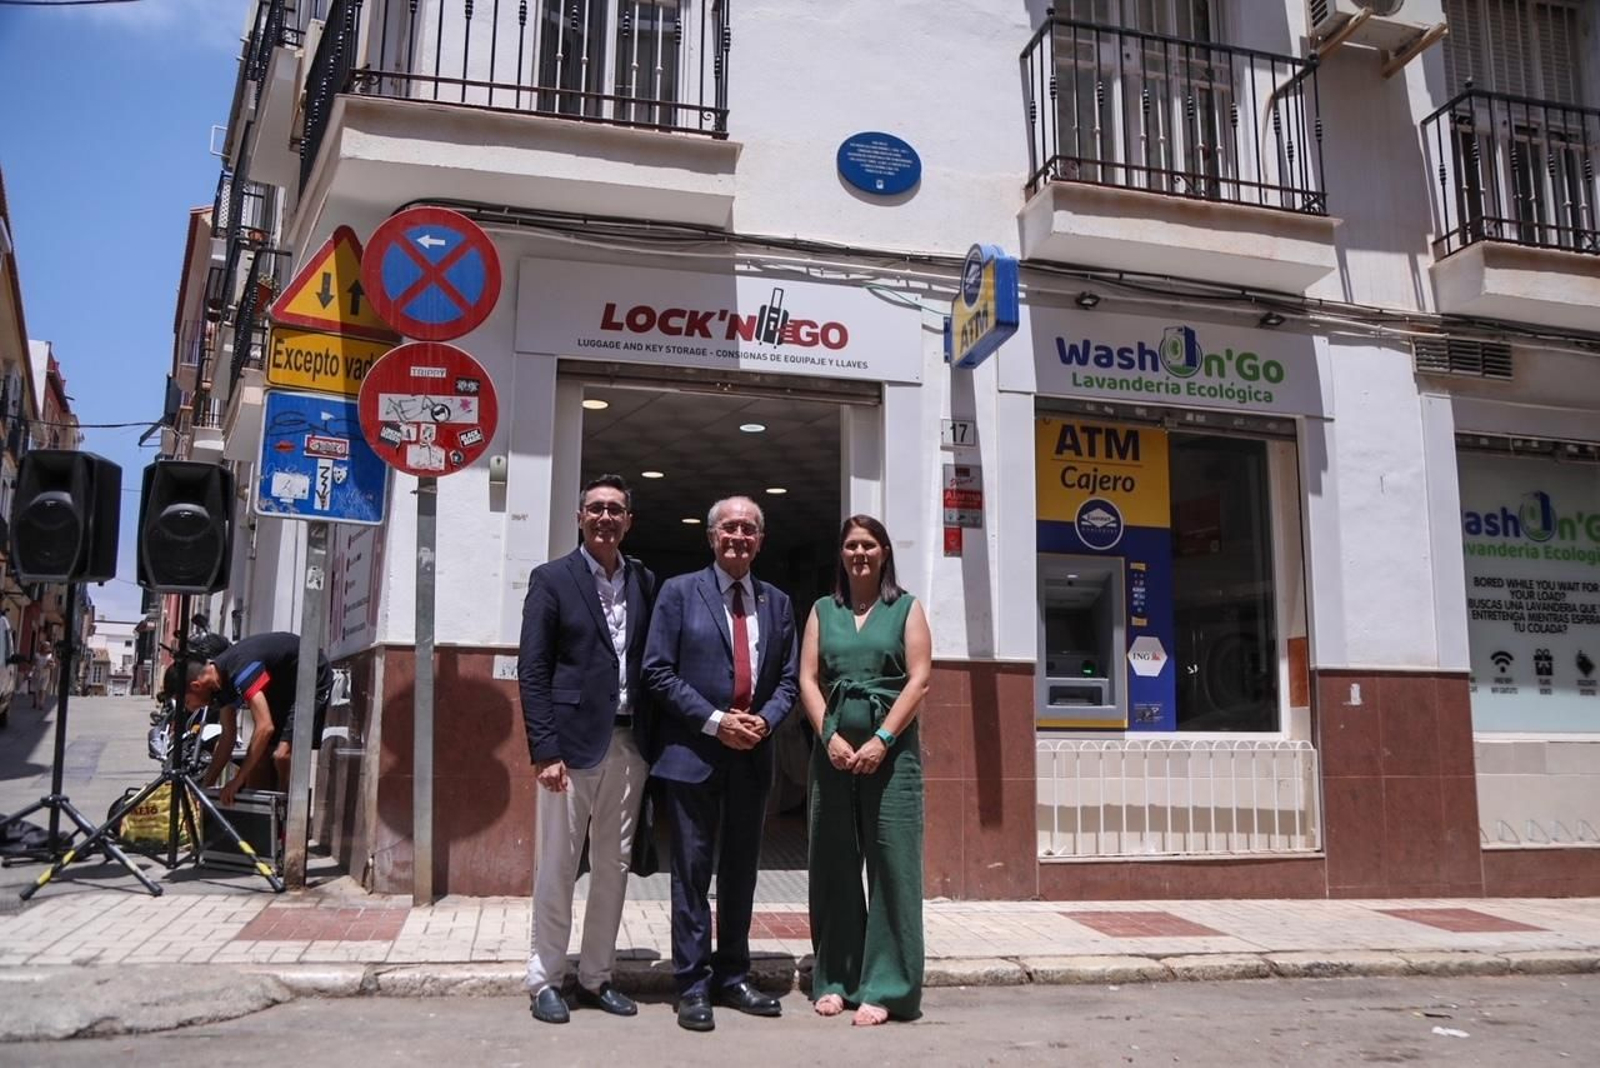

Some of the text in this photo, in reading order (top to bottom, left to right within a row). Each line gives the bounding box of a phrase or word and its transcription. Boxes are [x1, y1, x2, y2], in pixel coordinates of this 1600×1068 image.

[600, 302, 849, 351] LOCK'N GO
[960, 303, 989, 354] ATM
[272, 338, 339, 382] Excepto
[577, 338, 621, 350] LUGGAGE
[623, 341, 643, 351] AND
[645, 344, 663, 353] KEY
[665, 345, 707, 357] STORAGE
[715, 349, 768, 361] CONSIGNAS
[770, 353, 782, 362] DE
[784, 355, 826, 366] EQUIPAJE
[828, 358, 834, 366] Y
[835, 360, 869, 370] LLAVES
[1071, 372, 1274, 404] Lavandería Ecológica
[949, 423, 969, 443] 17
[1054, 424, 1140, 461] ATM
[1060, 465, 1135, 495] Cajero
[1461, 506, 1521, 538] ash
[1473, 576, 1599, 592] BORED WHILE YOU WAIT FOR
[1509, 589, 1567, 601] YOUR LOAD?
[1468, 598, 1502, 609] BUSCAS
[1504, 600, 1524, 611] UNA
[1579, 603, 1597, 614] QUE
[1471, 609, 1525, 621] ENTRETENGA
[1528, 612, 1570, 624] MIENTRAS
[1513, 622, 1568, 634] TU COLADA?
[1132, 652, 1150, 661] ING
